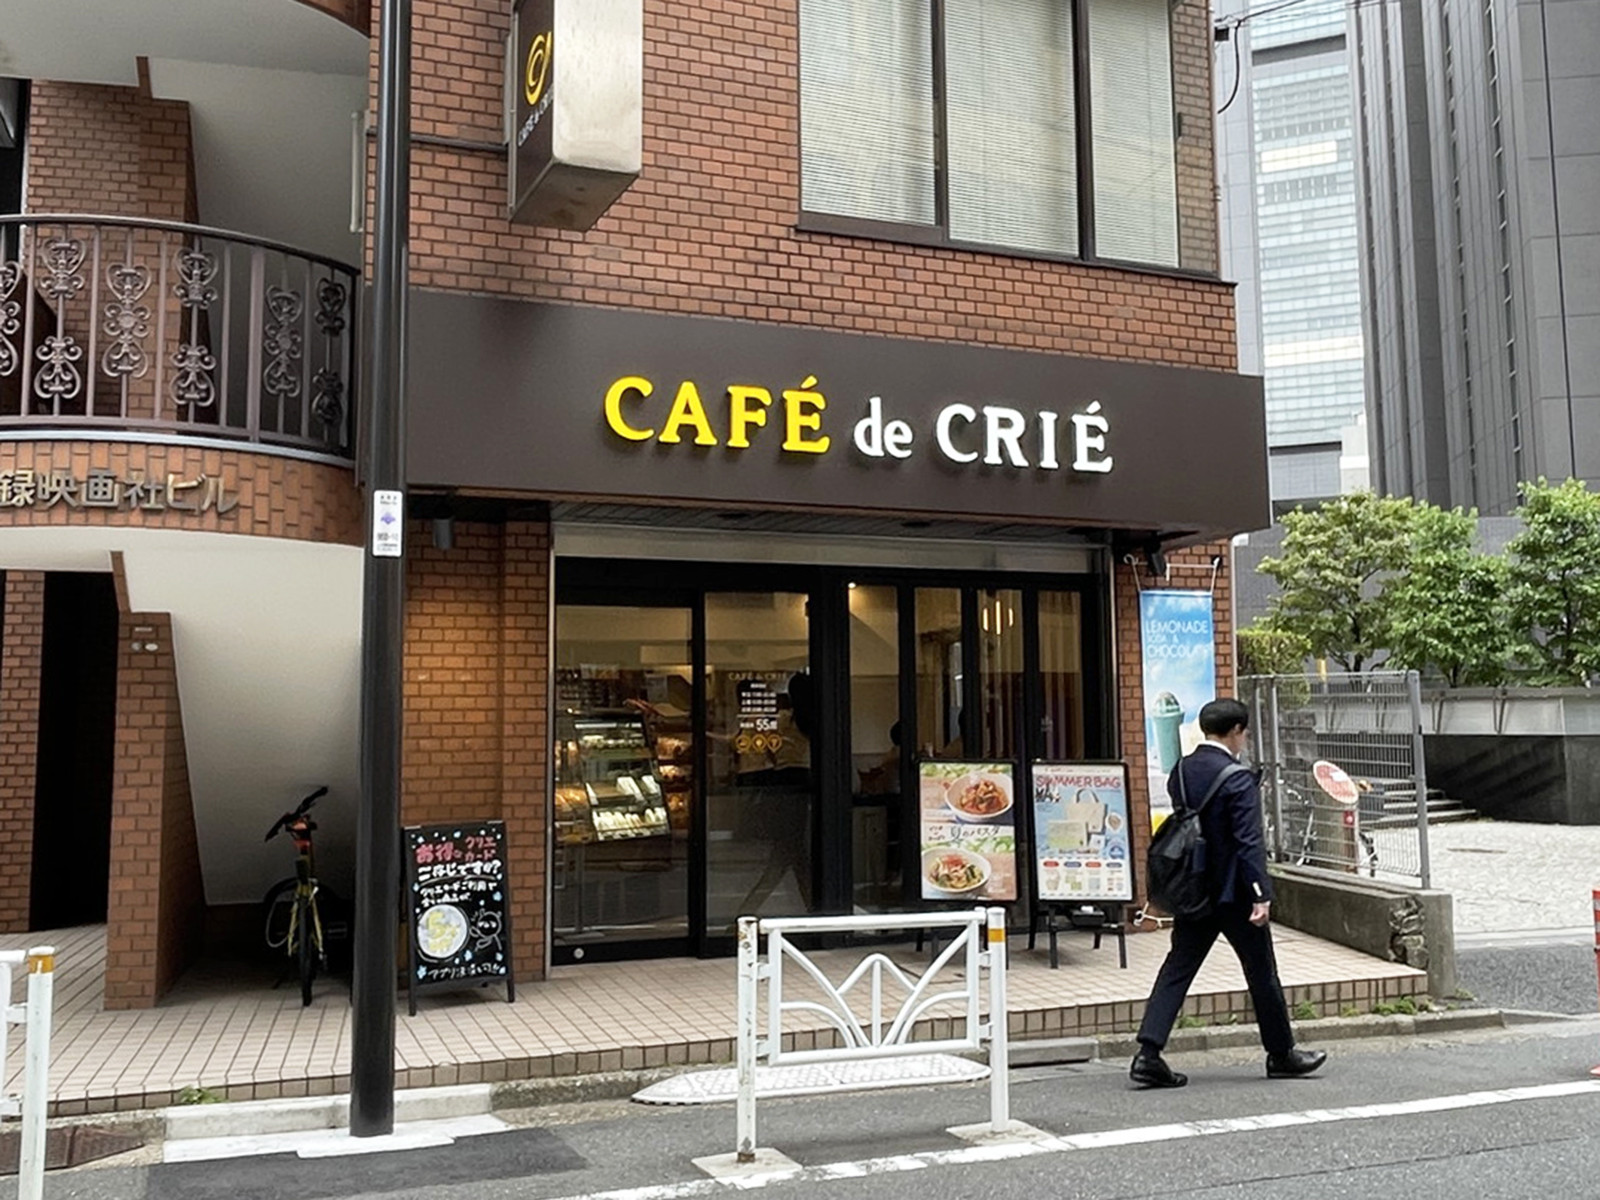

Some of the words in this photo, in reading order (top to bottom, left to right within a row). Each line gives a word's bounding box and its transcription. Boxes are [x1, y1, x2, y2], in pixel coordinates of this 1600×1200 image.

[603, 375, 831, 454] CAFÉ
[854, 397, 914, 459] de
[936, 400, 1115, 474] CRIÉ
[1145, 620, 1209, 634] LEMONADE
[1147, 644, 1210, 658] CHOCOL
[1093, 775, 1121, 788] BAG
